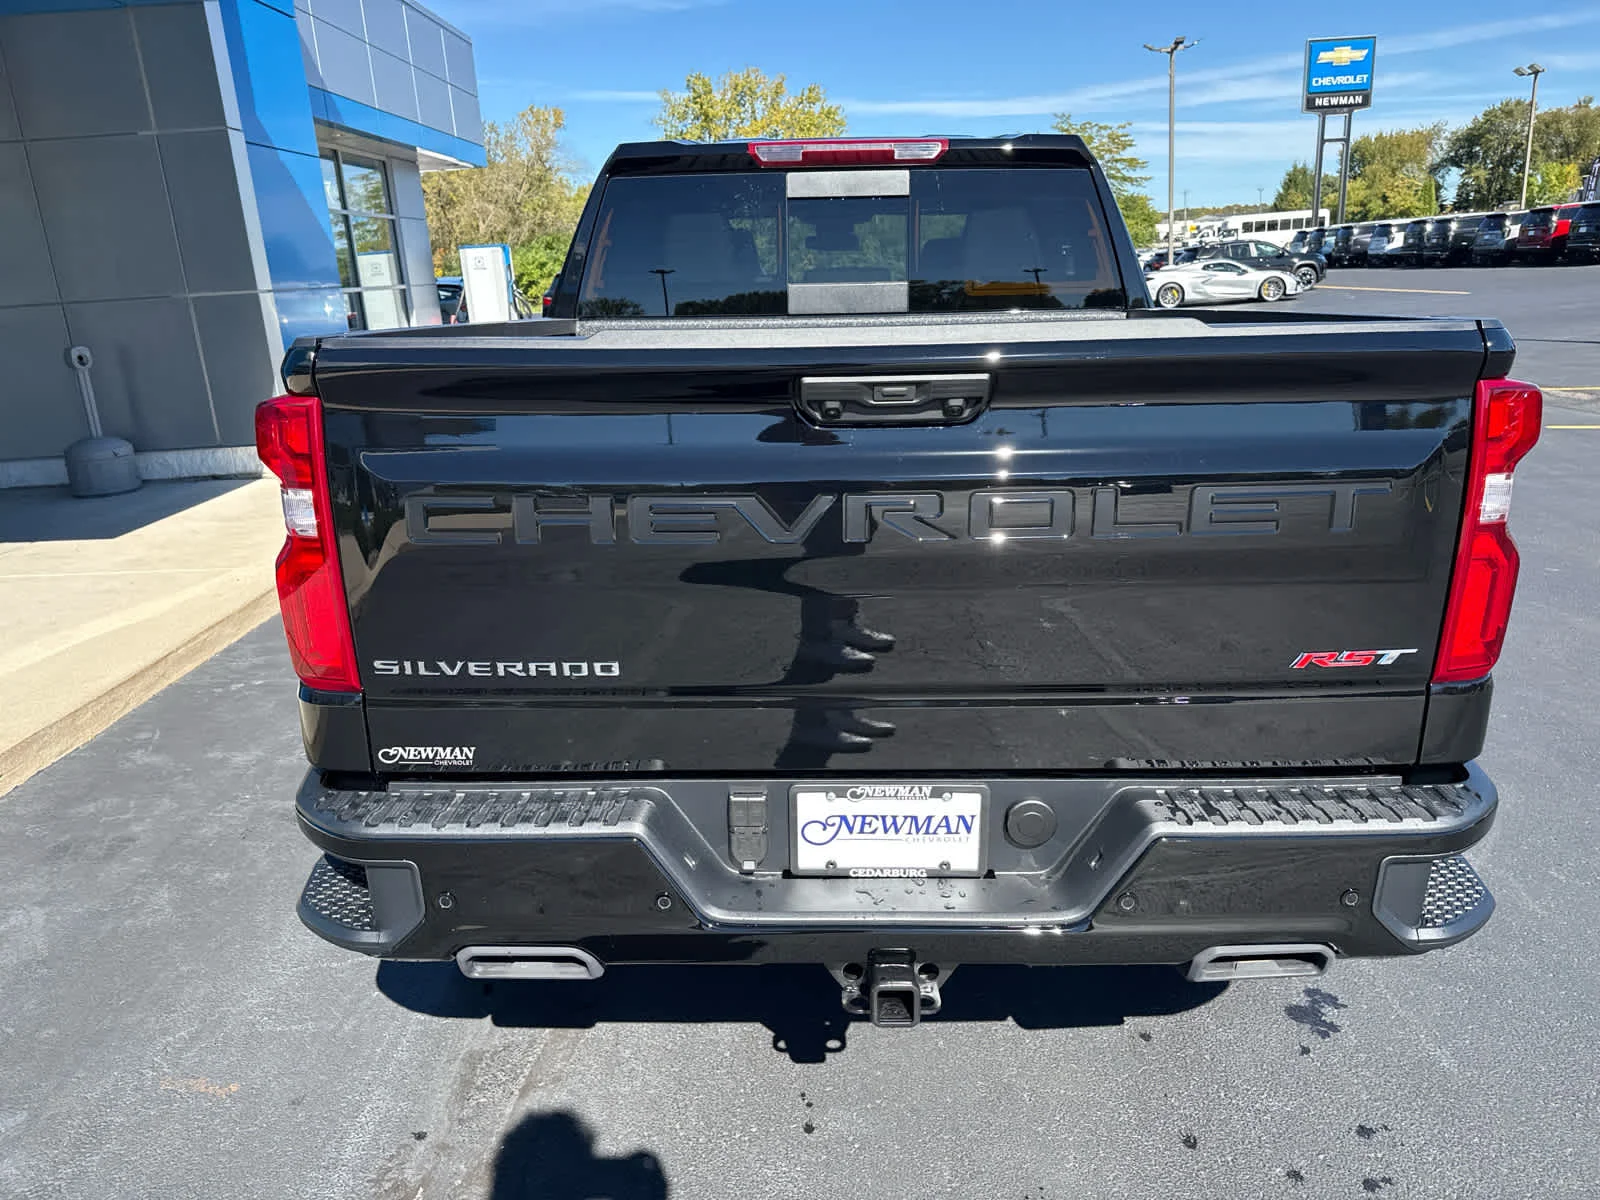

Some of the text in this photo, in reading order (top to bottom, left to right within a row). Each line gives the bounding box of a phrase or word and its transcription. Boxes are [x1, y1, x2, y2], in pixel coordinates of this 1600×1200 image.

[1312, 74, 1368, 86] CHEVROLET
[1315, 95, 1362, 106] NEWMAN
[405, 480, 1393, 545] CHEVROLET
[1289, 648, 1419, 669] RST
[373, 659, 621, 678] SILVERADO
[378, 746, 476, 764] NEWMAN
[847, 786, 932, 802] NEWMAN
[801, 815, 976, 846] NEWMAN
[904, 836, 970, 844] CHEVROLET
[849, 868, 927, 878] CEDARBURG
